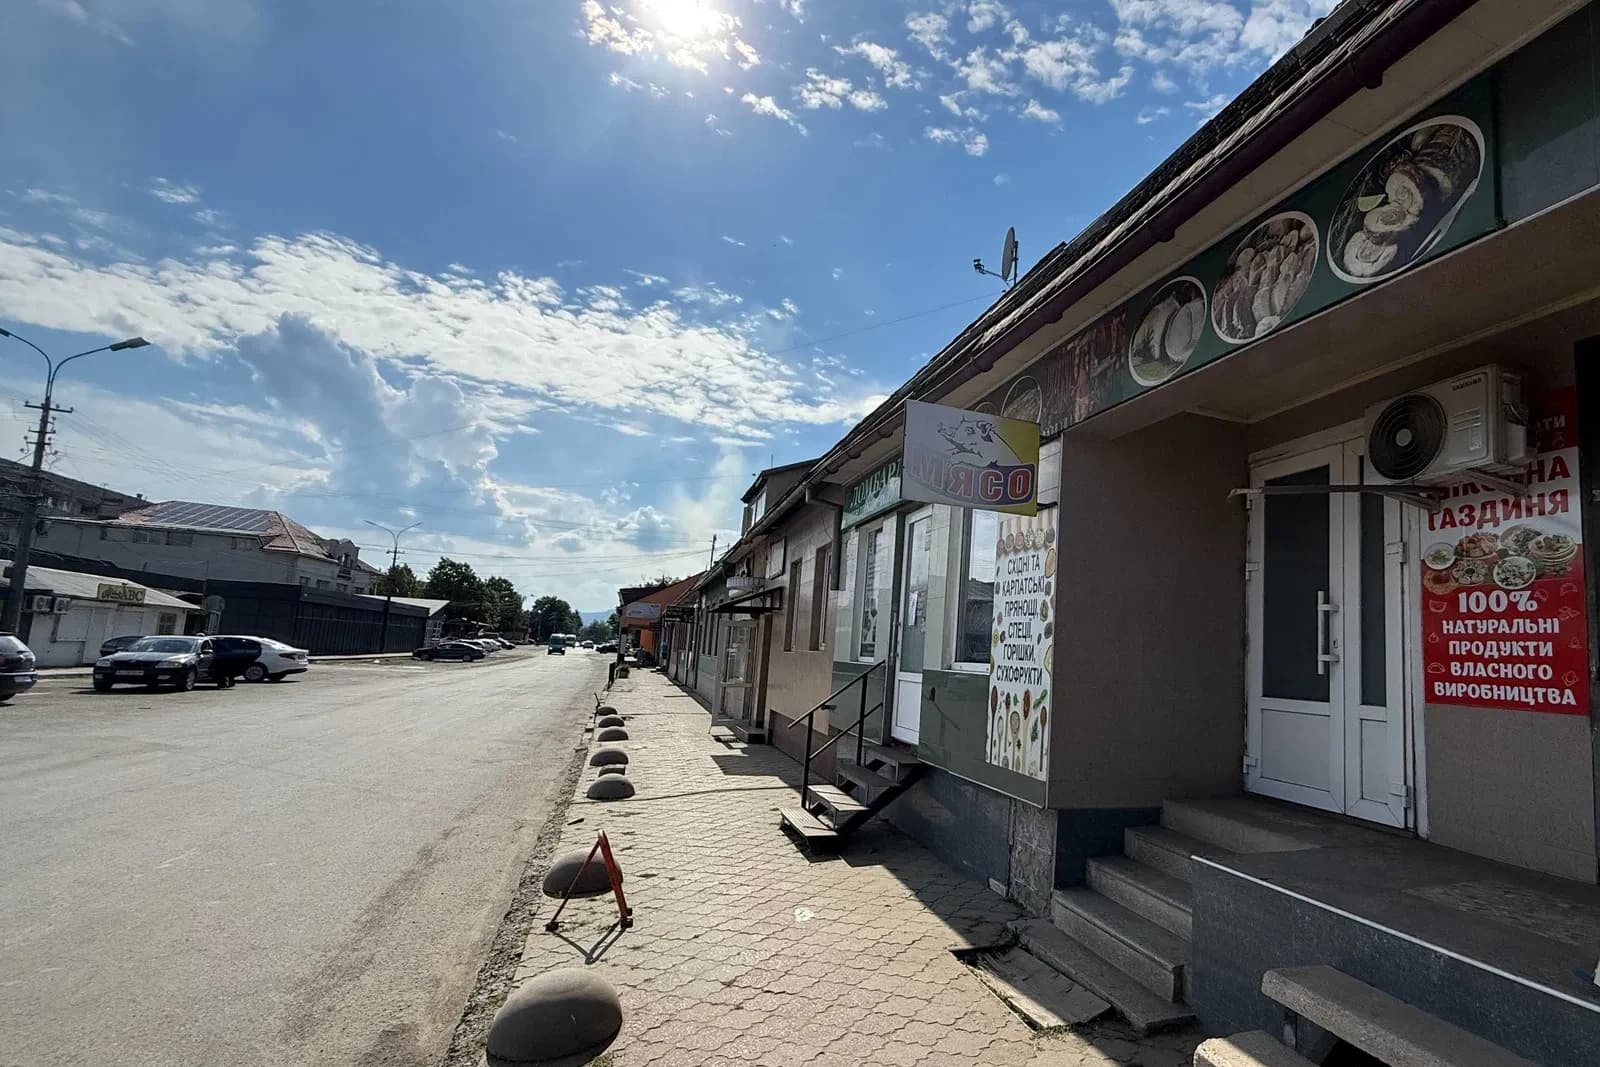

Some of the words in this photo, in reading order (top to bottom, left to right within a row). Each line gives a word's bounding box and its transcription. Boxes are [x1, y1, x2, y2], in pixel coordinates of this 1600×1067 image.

[1007, 557, 1029, 576] СХІДНІ
[1032, 554, 1040, 571] ТА
[1002, 575, 1045, 597] КАРПАТСЬКІ
[1458, 590, 1538, 614] 100%
[1442, 617, 1560, 635] НАТУРАЛЬНІ
[1449, 640, 1553, 660] ПРОДУКТИ
[997, 665, 1043, 686] СУХОФРУКТИ
[1450, 661, 1553, 680] ВЛАСНОГО
[1434, 682, 1577, 706] ВИРОБНИЦТВА
